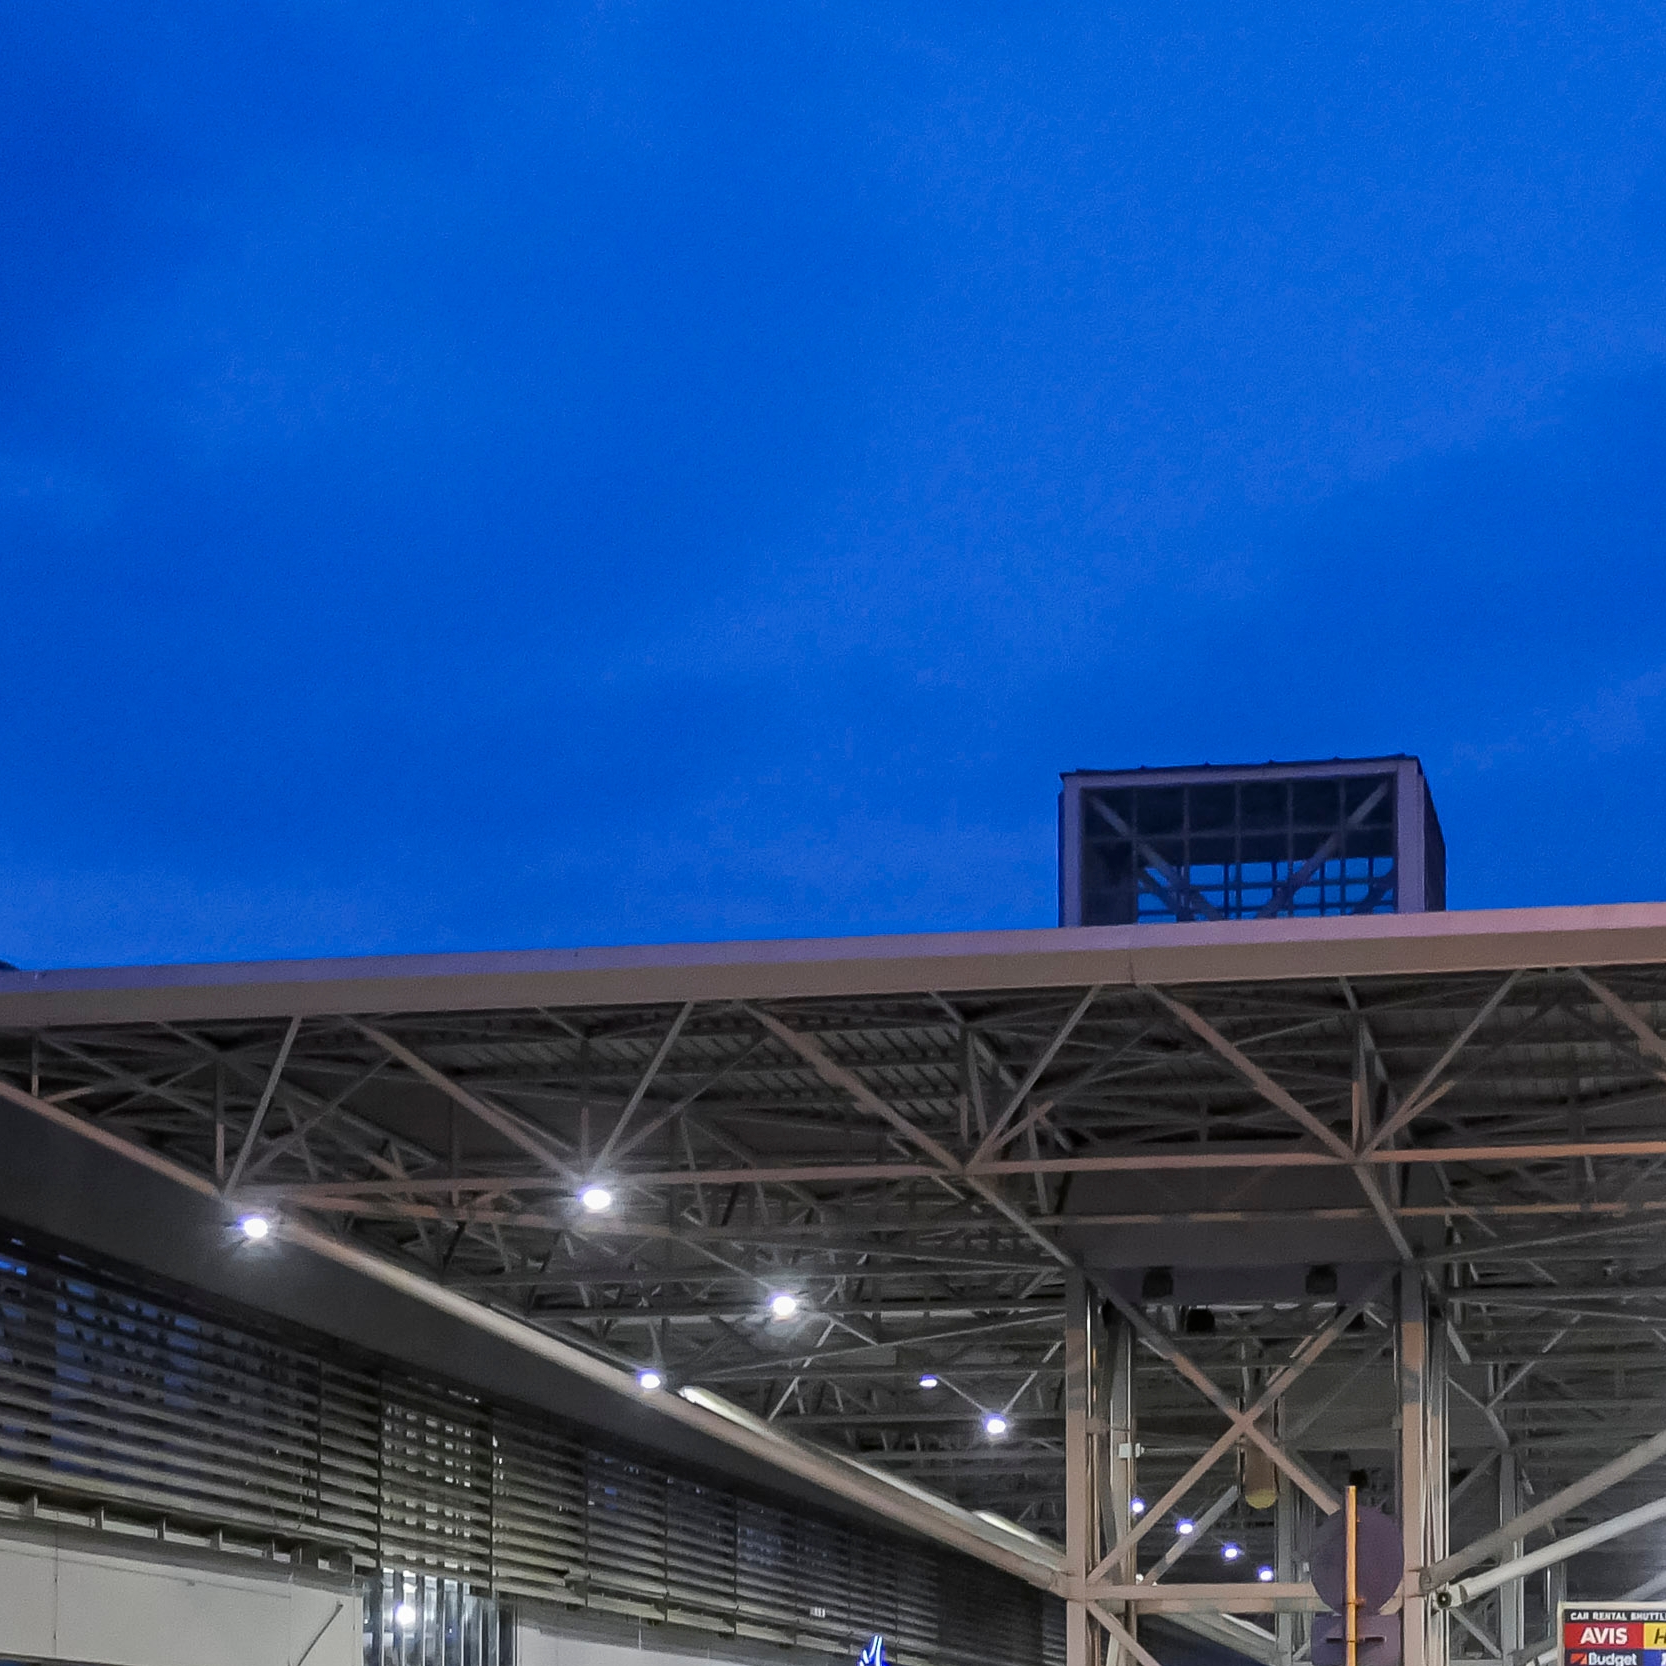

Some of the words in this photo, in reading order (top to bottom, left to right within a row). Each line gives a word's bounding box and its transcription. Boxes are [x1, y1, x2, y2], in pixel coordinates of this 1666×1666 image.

[1570, 1611, 1590, 1621] CAR
[1593, 1611, 1627, 1621] RENTAL
[1580, 1627, 1628, 1645] AVIS
